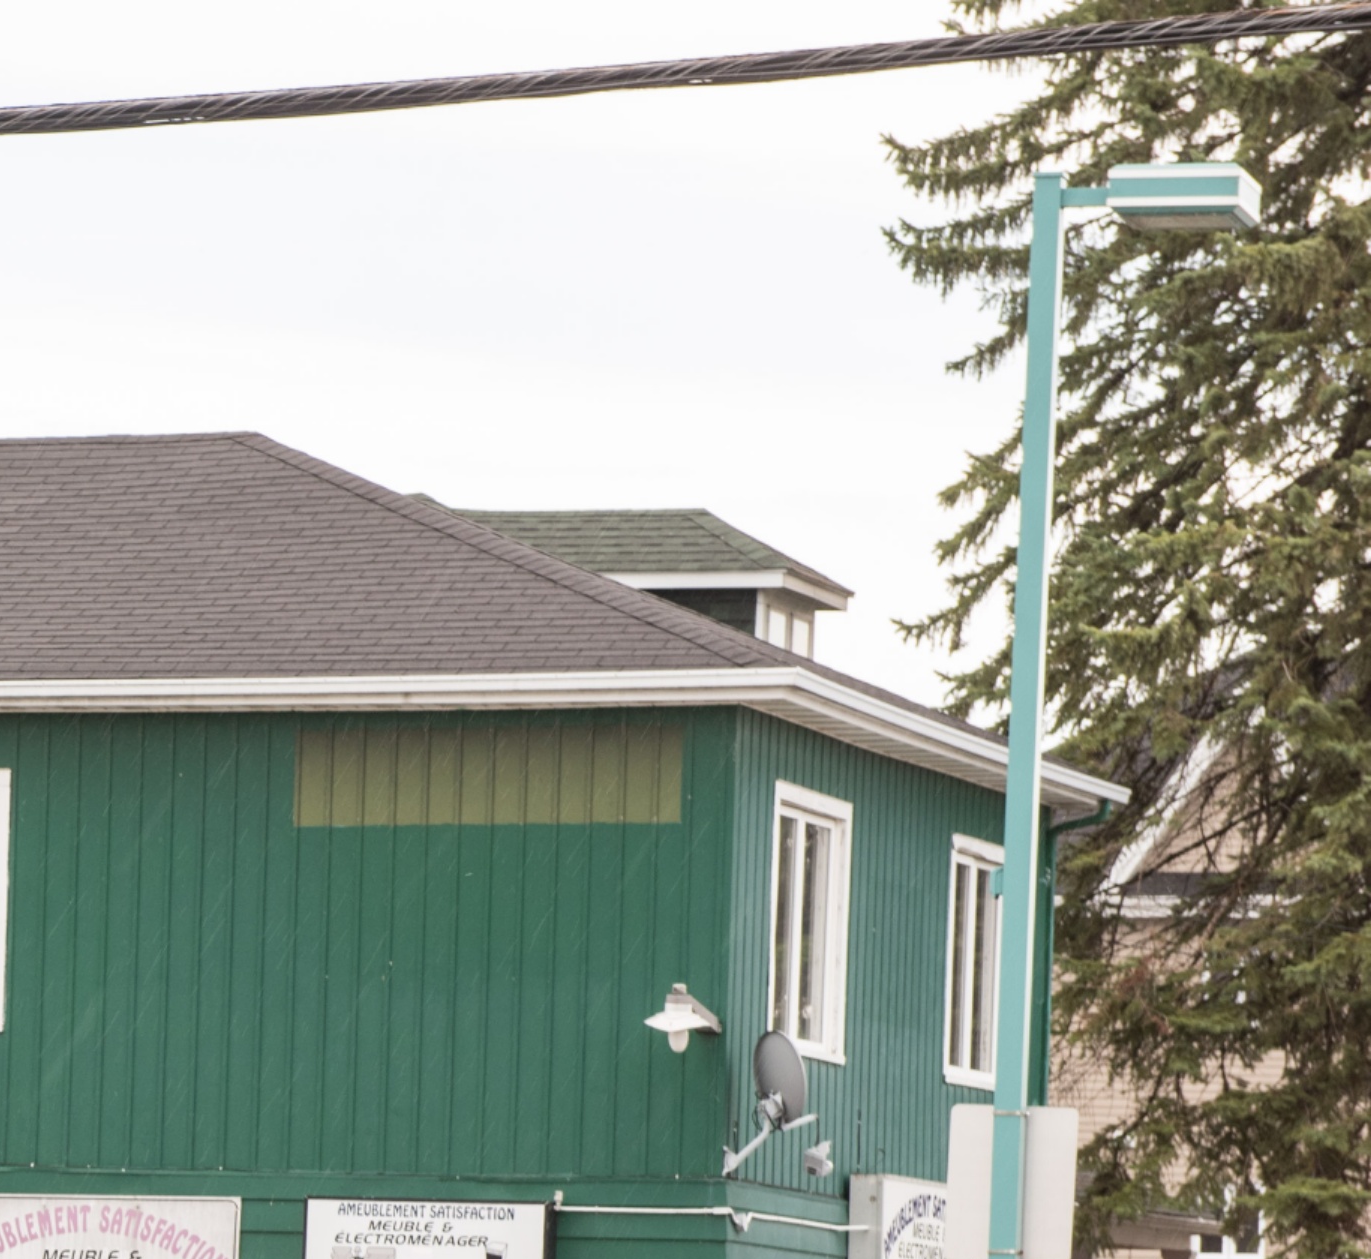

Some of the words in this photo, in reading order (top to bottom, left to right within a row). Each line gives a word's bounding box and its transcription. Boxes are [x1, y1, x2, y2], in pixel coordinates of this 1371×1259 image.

[337, 1202, 426, 1218] AMEUBLEMENT
[430, 1205, 515, 1221] SATISFACTION
[367, 1220, 434, 1233] MEUBLE
[442, 1222, 453, 1233] &
[884, 1194, 931, 1259] AMEUBLEMENT
[913, 1222, 940, 1242] MEUBLE
